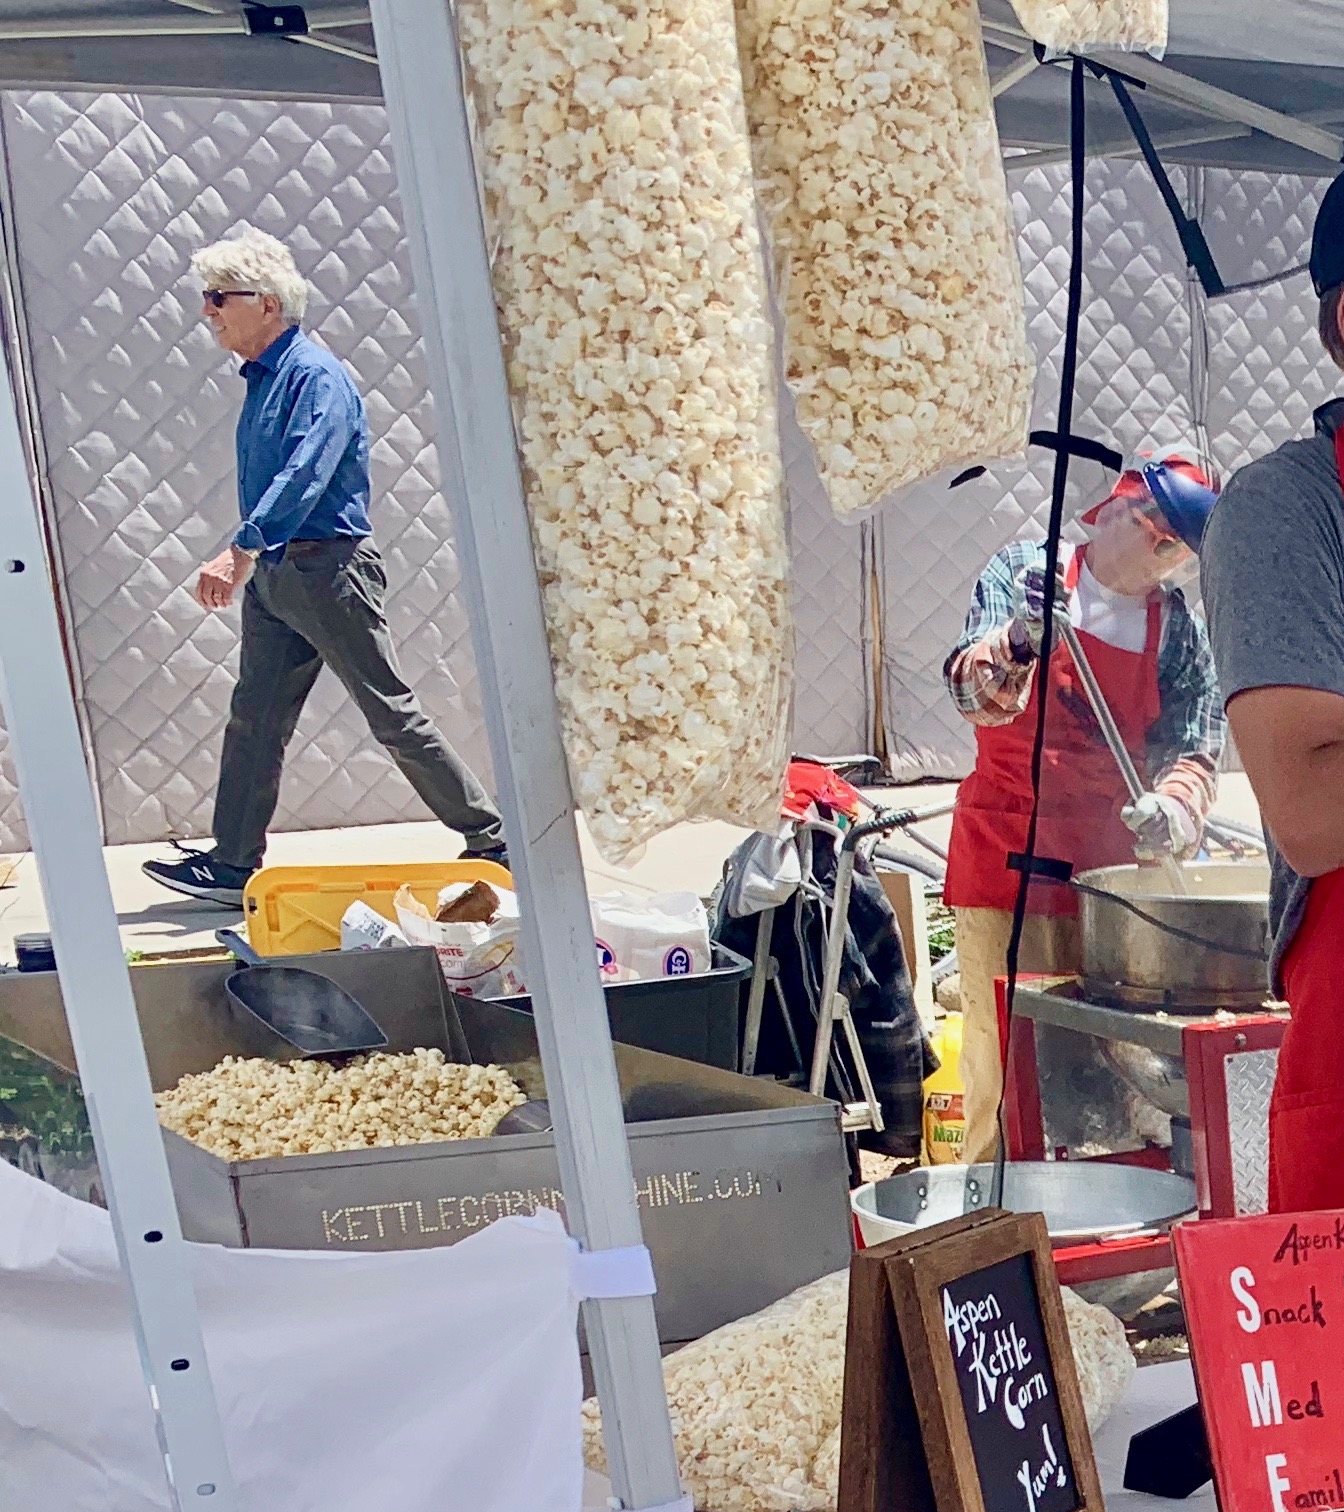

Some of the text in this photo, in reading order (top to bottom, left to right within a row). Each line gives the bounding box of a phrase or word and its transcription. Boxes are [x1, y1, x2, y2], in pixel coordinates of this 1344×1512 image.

[1273, 1223, 1332, 1265] Aspen
[943, 1287, 1001, 1357] Aspen
[1230, 1266, 1327, 1333] Snack
[969, 1321, 1032, 1413] Kettle
[1241, 1360, 1325, 1427] Med
[1004, 1372, 1048, 1430] Corn
